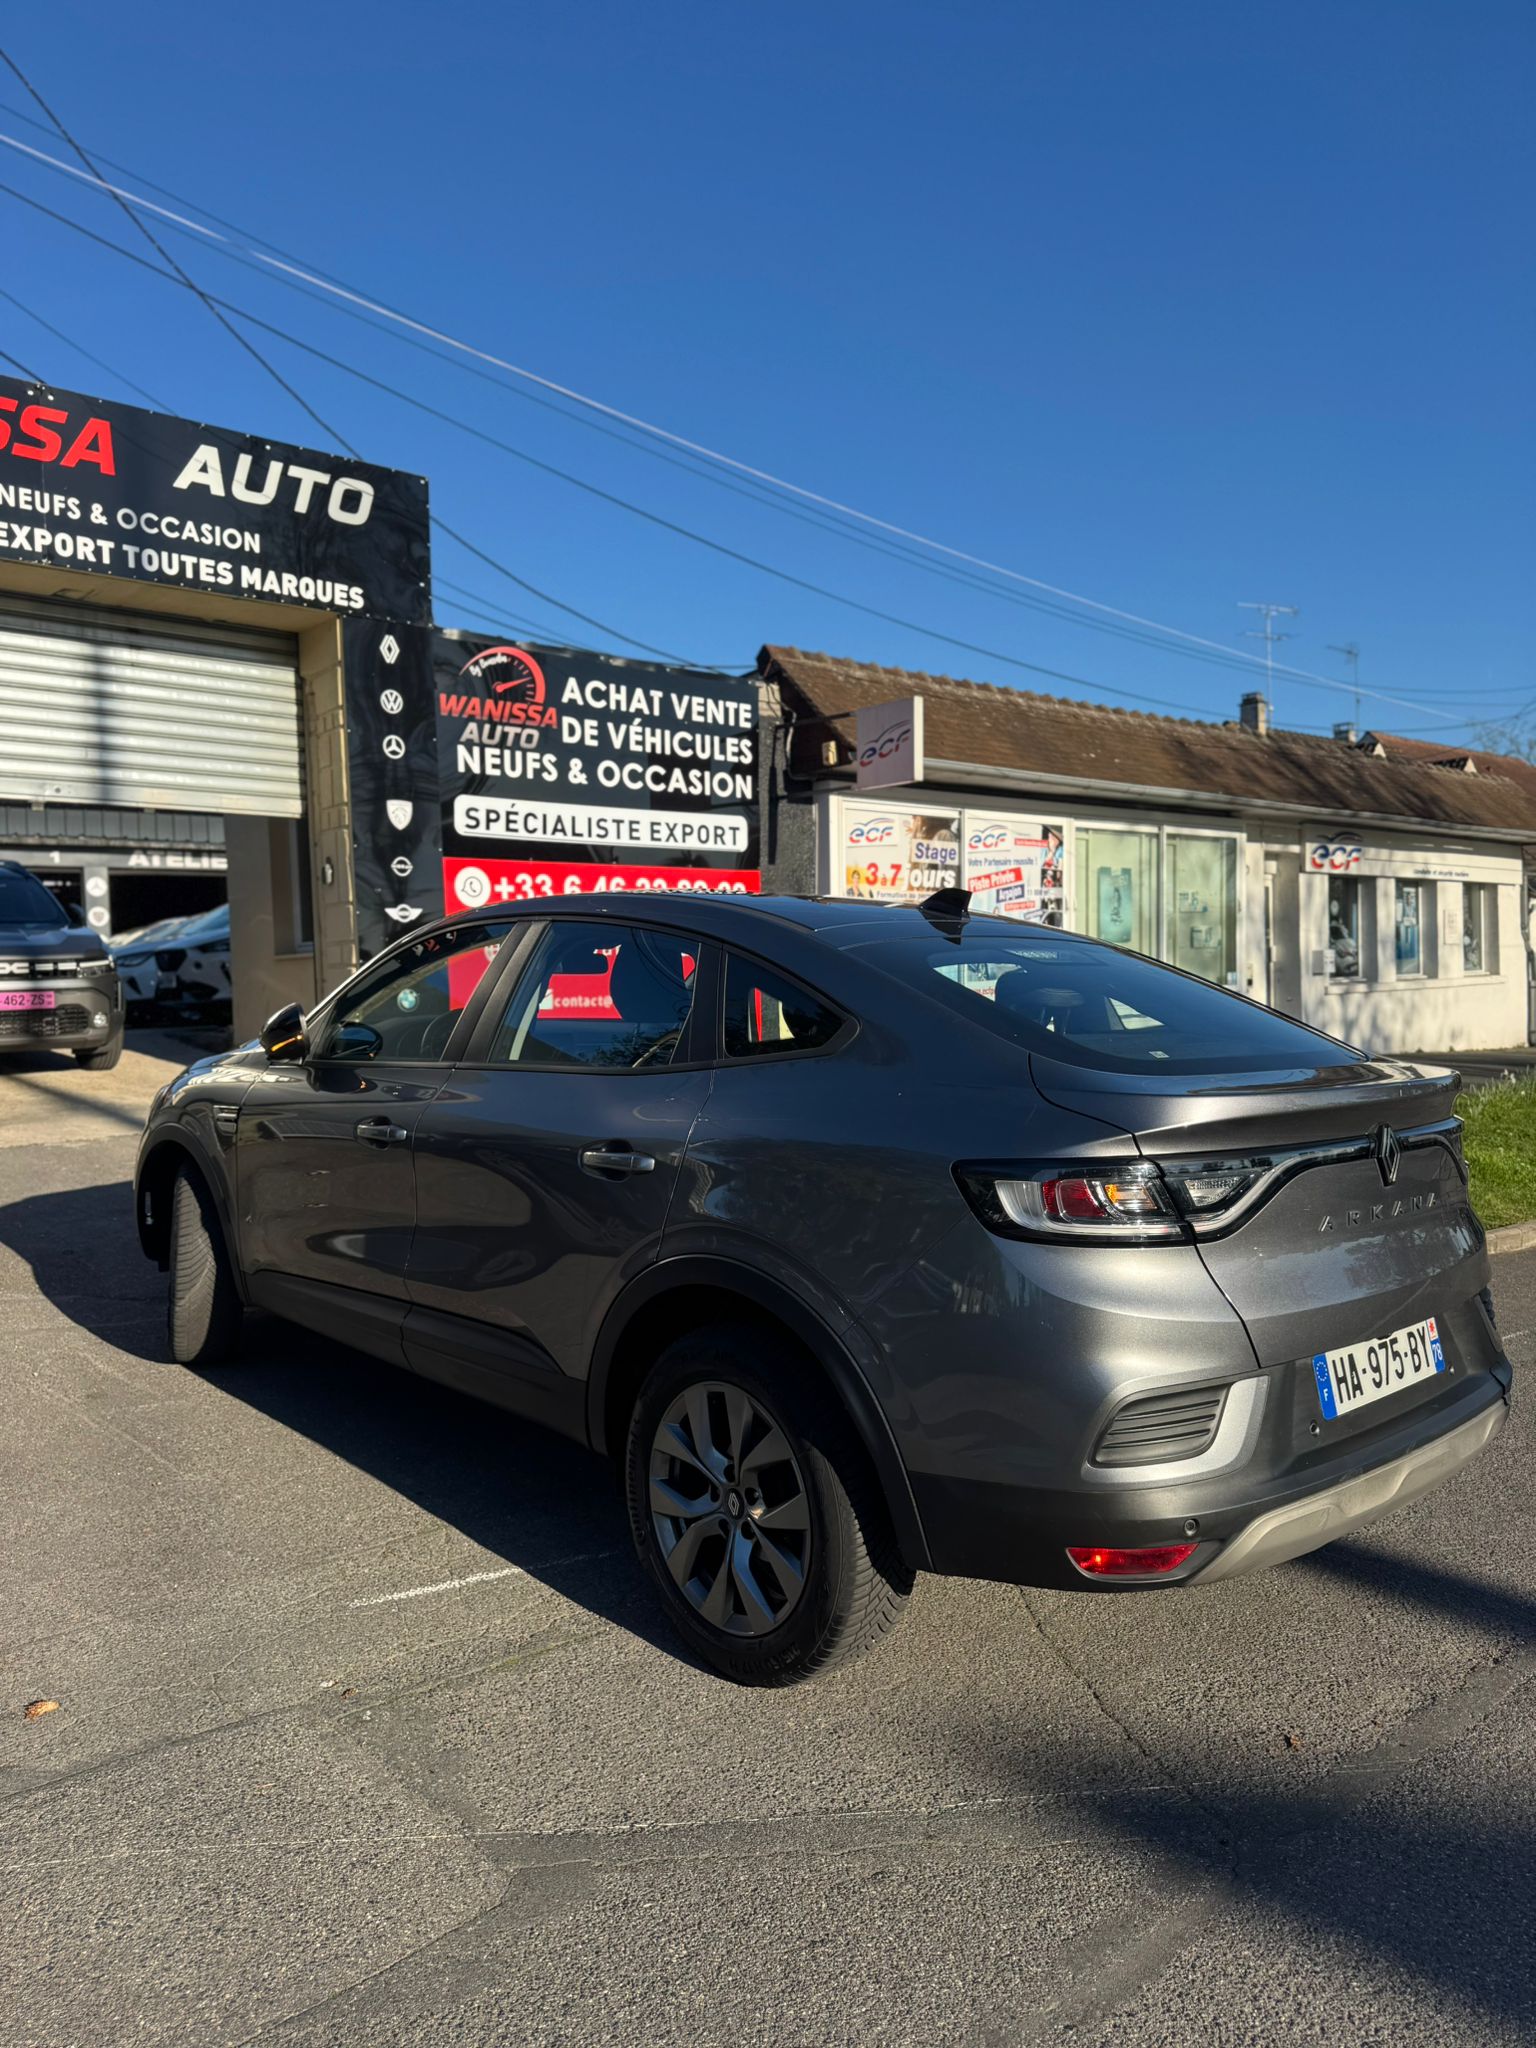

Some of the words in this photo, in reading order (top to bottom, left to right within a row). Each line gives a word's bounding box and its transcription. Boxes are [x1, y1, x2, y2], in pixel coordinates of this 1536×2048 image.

[173, 444, 375, 526] AUTO
[0, 483, 82, 520] NEUFS
[90, 503, 108, 526] &
[117, 508, 261, 554] OCCASION
[122, 544, 234, 586] TOUTES
[240, 564, 365, 610] MARQUES
[439, 692, 558, 729] WANISSA
[560, 677, 663, 717] ACHAT
[670, 692, 753, 729] VENTE
[460, 721, 540, 750] AUTO
[561, 716, 599, 747] DE
[606, 717, 753, 765] VÉHICULES
[456, 745, 558, 782] NEUFS
[567, 758, 588, 785] &
[597, 759, 753, 800] OCCASION
[465, 803, 641, 841] SPÉCIALISTE
[650, 821, 741, 846] EXPORT
[865, 863, 879, 886] 3
[890, 864, 902, 886] 7
[915, 842, 957, 865] Stage
[1318, 1192, 1436, 1232] ARKANA
[1331, 1326, 1430, 1404] HA-975-BY
[1432, 1343, 1443, 1362] 78
[1323, 1388, 1329, 1402] F
